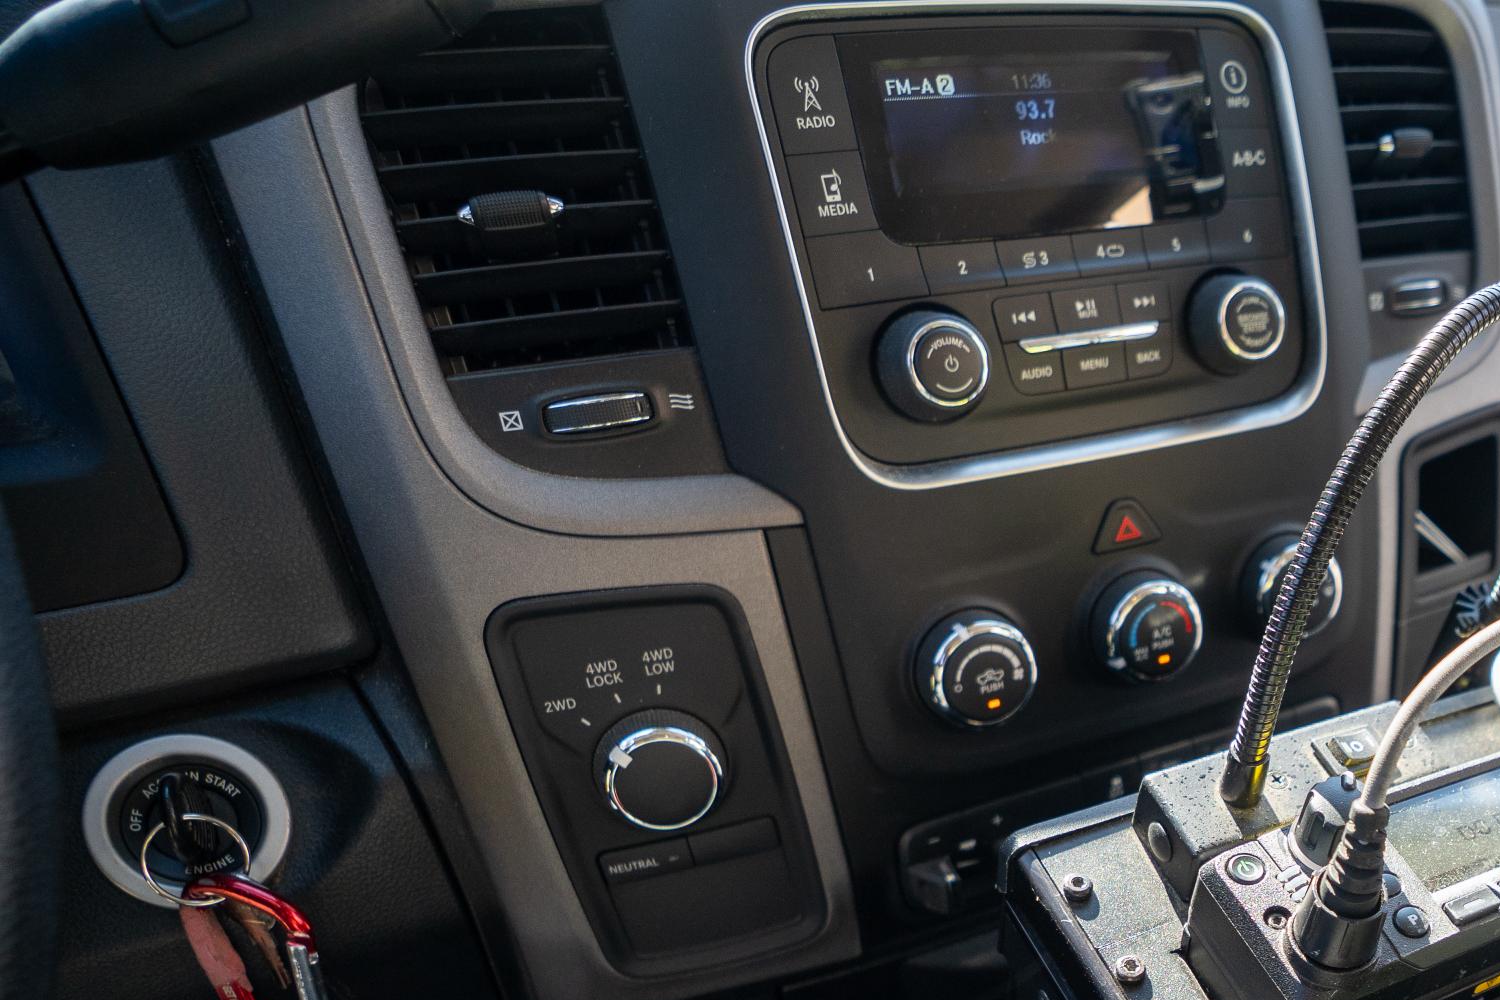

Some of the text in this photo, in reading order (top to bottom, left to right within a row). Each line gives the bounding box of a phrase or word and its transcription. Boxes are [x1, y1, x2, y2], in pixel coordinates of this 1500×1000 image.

[885, 78, 934, 96] FM-A
[1015, 99, 1056, 120] 93.7
[796, 115, 836, 130] RADIO
[817, 202, 859, 218] MEDIA
[1040, 251, 1050, 266] 3
[1096, 245, 1106, 259] 4
[867, 266, 876, 283] 1
[957, 260, 969, 276] 2
[930, 337, 964, 351] VOLUME
[1080, 356, 1109, 371] MENU
[1136, 350, 1161, 363] BACK
[1021, 366, 1053, 381] AUDIO
[642, 648, 673, 663] 4WD
[586, 659, 618, 675] 4WD
[645, 660, 675, 676] LOW
[586, 671, 623, 689] LOCK
[981, 681, 1005, 695] PUSH
[544, 697, 577, 714] 2WD
[142, 779, 161, 799] AC
[205, 773, 241, 798] START
[129, 808, 143, 832] OFF
[608, 857, 660, 875] NEUTRAL
[1406, 914, 1418, 927] P
